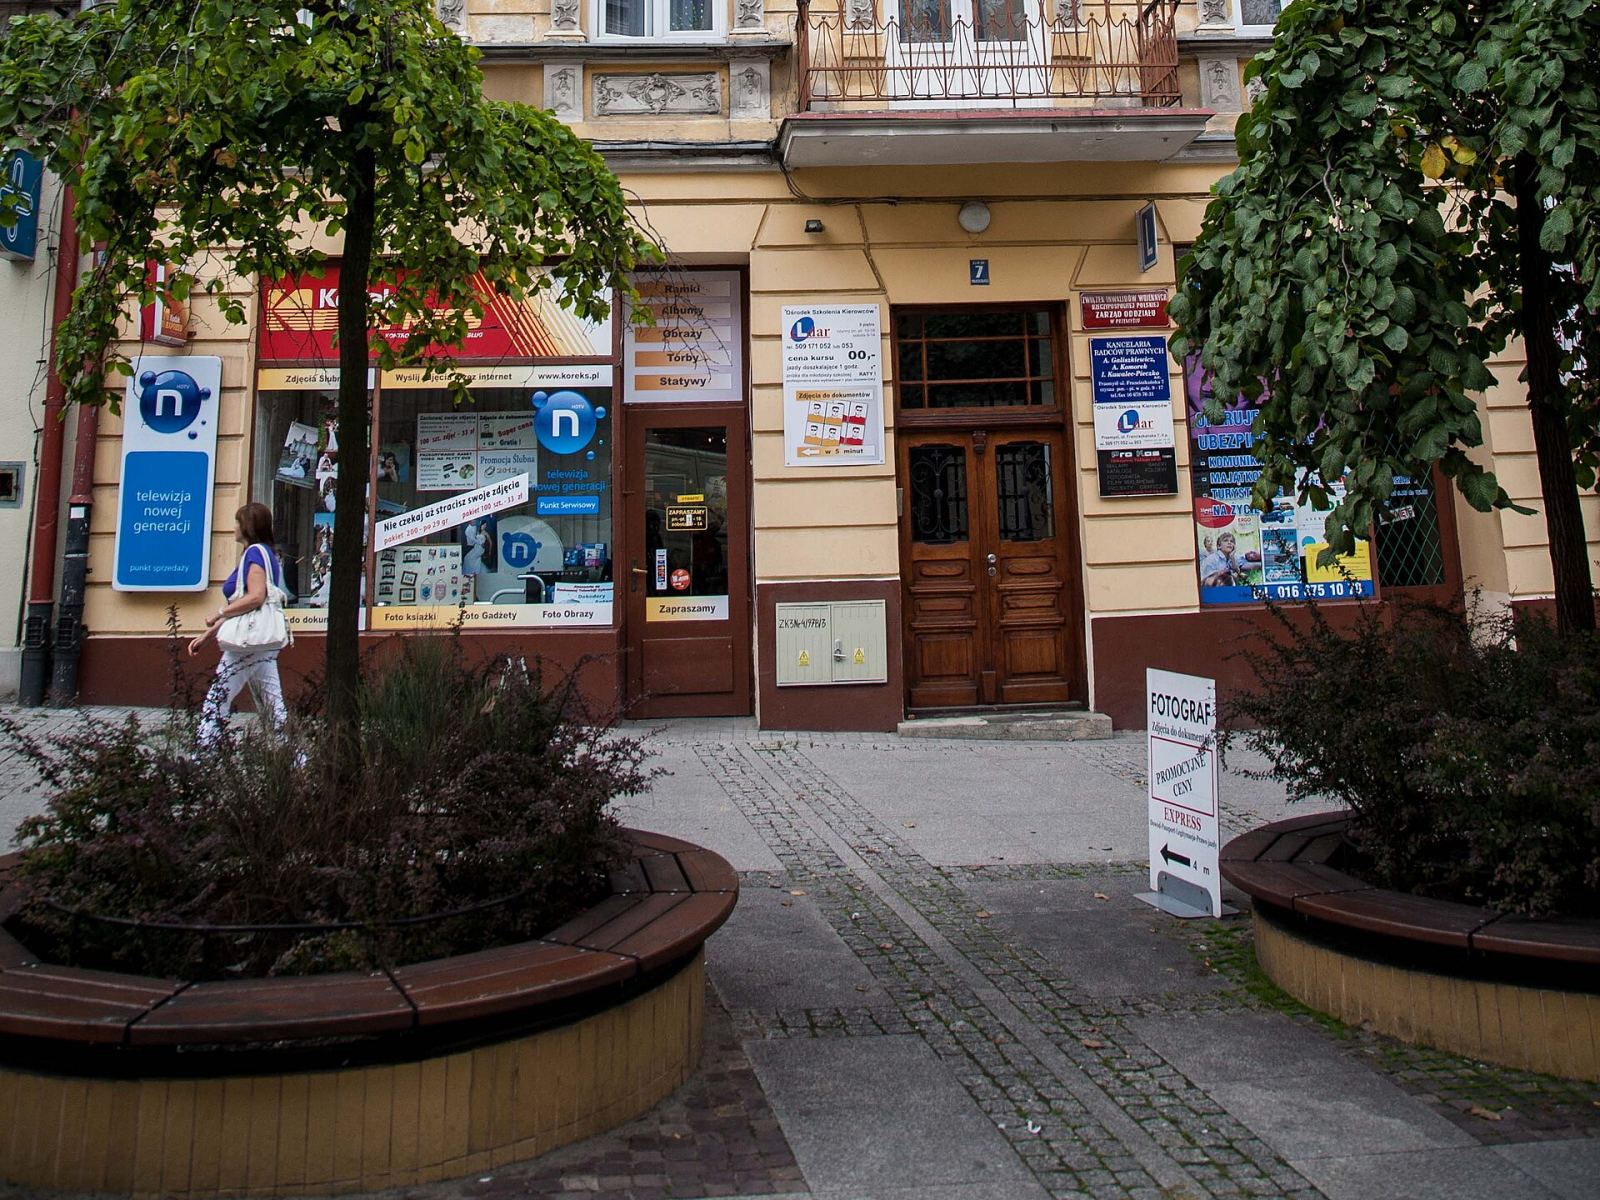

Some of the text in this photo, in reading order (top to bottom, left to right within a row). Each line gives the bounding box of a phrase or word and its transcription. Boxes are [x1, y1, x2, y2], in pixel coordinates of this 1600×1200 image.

[975, 266, 984, 278] 7
[664, 284, 700, 294] Ramki
[662, 306, 704, 316] Albumy
[1096, 310, 1156, 318] ZARZĄD ODDZIAŁU
[662, 330, 702, 340] Obrazy
[1126, 348, 1164, 356] PRAWNYCH
[666, 354, 699, 364] Torby
[286, 374, 317, 384] Zdjęcia
[396, 373, 420, 383] Wyślij
[478, 373, 512, 381] internet
[538, 372, 600, 382] www.koreks.pl
[660, 377, 706, 387] Statywy
[155, 390, 182, 416] n
[552, 409, 579, 437] n
[498, 426, 518, 438] Super
[480, 454, 535, 466] Promocja Ślubna
[546, 470, 588, 482] telewizja
[532, 480, 606, 493] nowej generacji
[136, 490, 192, 504] telewizja
[384, 480, 520, 532] Nie czekaj aż stracisz swoje zdjęcia
[462, 492, 524, 519] pakiet 100 szt. 33 zł
[560, 501, 596, 510] Serwisowy
[1213, 505, 1227, 516] NA
[144, 505, 182, 520] nowej
[133, 519, 191, 534] generacji
[384, 518, 449, 546] pakiet 200 po 29 gr
[512, 542, 528, 559] n
[130, 564, 190, 573] punkt sprzedaży
[1278, 586, 1300, 598] 016
[1330, 584, 1344, 596] 10
[542, 610, 594, 619] Foto Obrazy
[658, 604, 716, 614] Zapraszamy
[384, 612, 437, 623] Foto książki
[482, 611, 517, 620] Gadżety
[1152, 692, 1211, 726] FOTOGRAF
[1152, 721, 1170, 736] Zdjęcia
[1170, 725, 1178, 736] do
[1156, 754, 1206, 785] PROMOCYJNE
[1172, 778, 1192, 797] CENY
[1164, 807, 1202, 832] EXPRESS
[1192, 860, 1210, 876] 4 m
